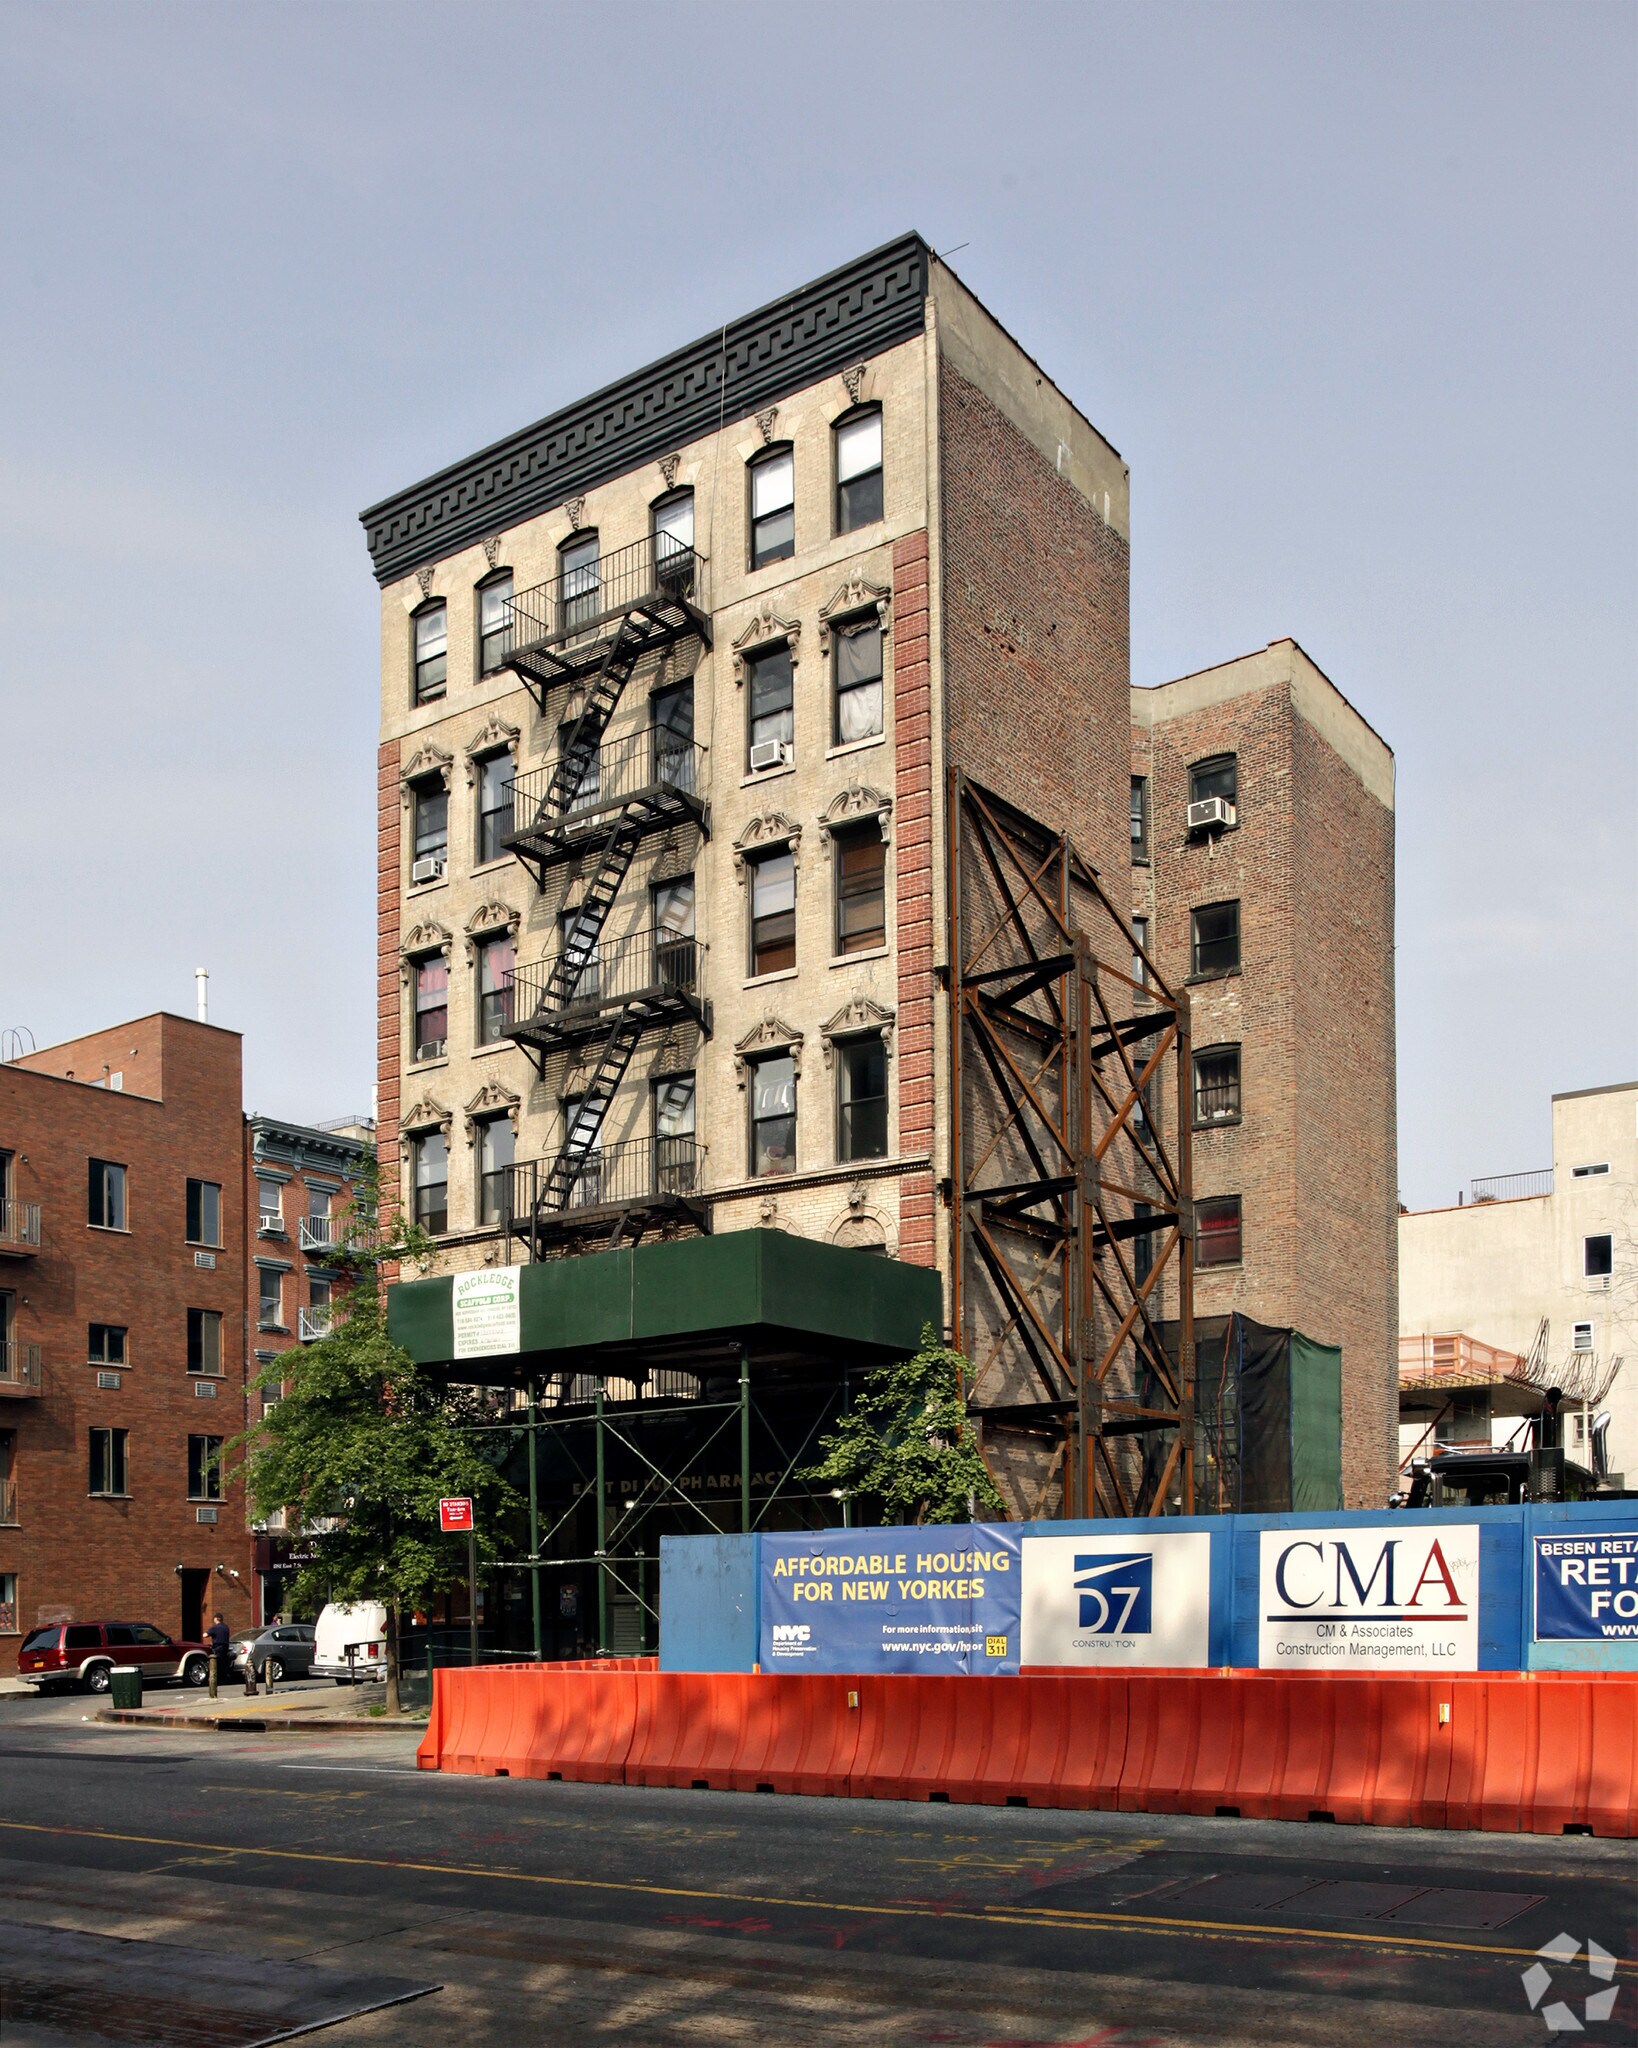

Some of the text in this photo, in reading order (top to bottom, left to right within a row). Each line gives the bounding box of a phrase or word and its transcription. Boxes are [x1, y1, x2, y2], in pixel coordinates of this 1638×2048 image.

[458, 1273, 515, 1296] ROCKLEDGE
[572, 1481, 614, 1496] EAT
[1541, 1541, 1596, 1555] BESEN
[773, 1554, 907, 1577] AFFORDABLE
[1275, 1538, 1468, 1609] CMA
[1561, 1557, 1638, 1586] RET
[793, 1578, 985, 1602] FOR NEW YORKES
[1073, 1587, 1141, 1634] D7
[773, 1625, 811, 1641] NYC
[882, 1625, 896, 1634] For
[897, 1626, 919, 1634] more
[1316, 1624, 1414, 1638] CM & Associates
[987, 1645, 1005, 1655] 311
[1072, 1640, 1136, 1648] CONSTRUTON
[1276, 1641, 1457, 1659] Construction Management, LLC
